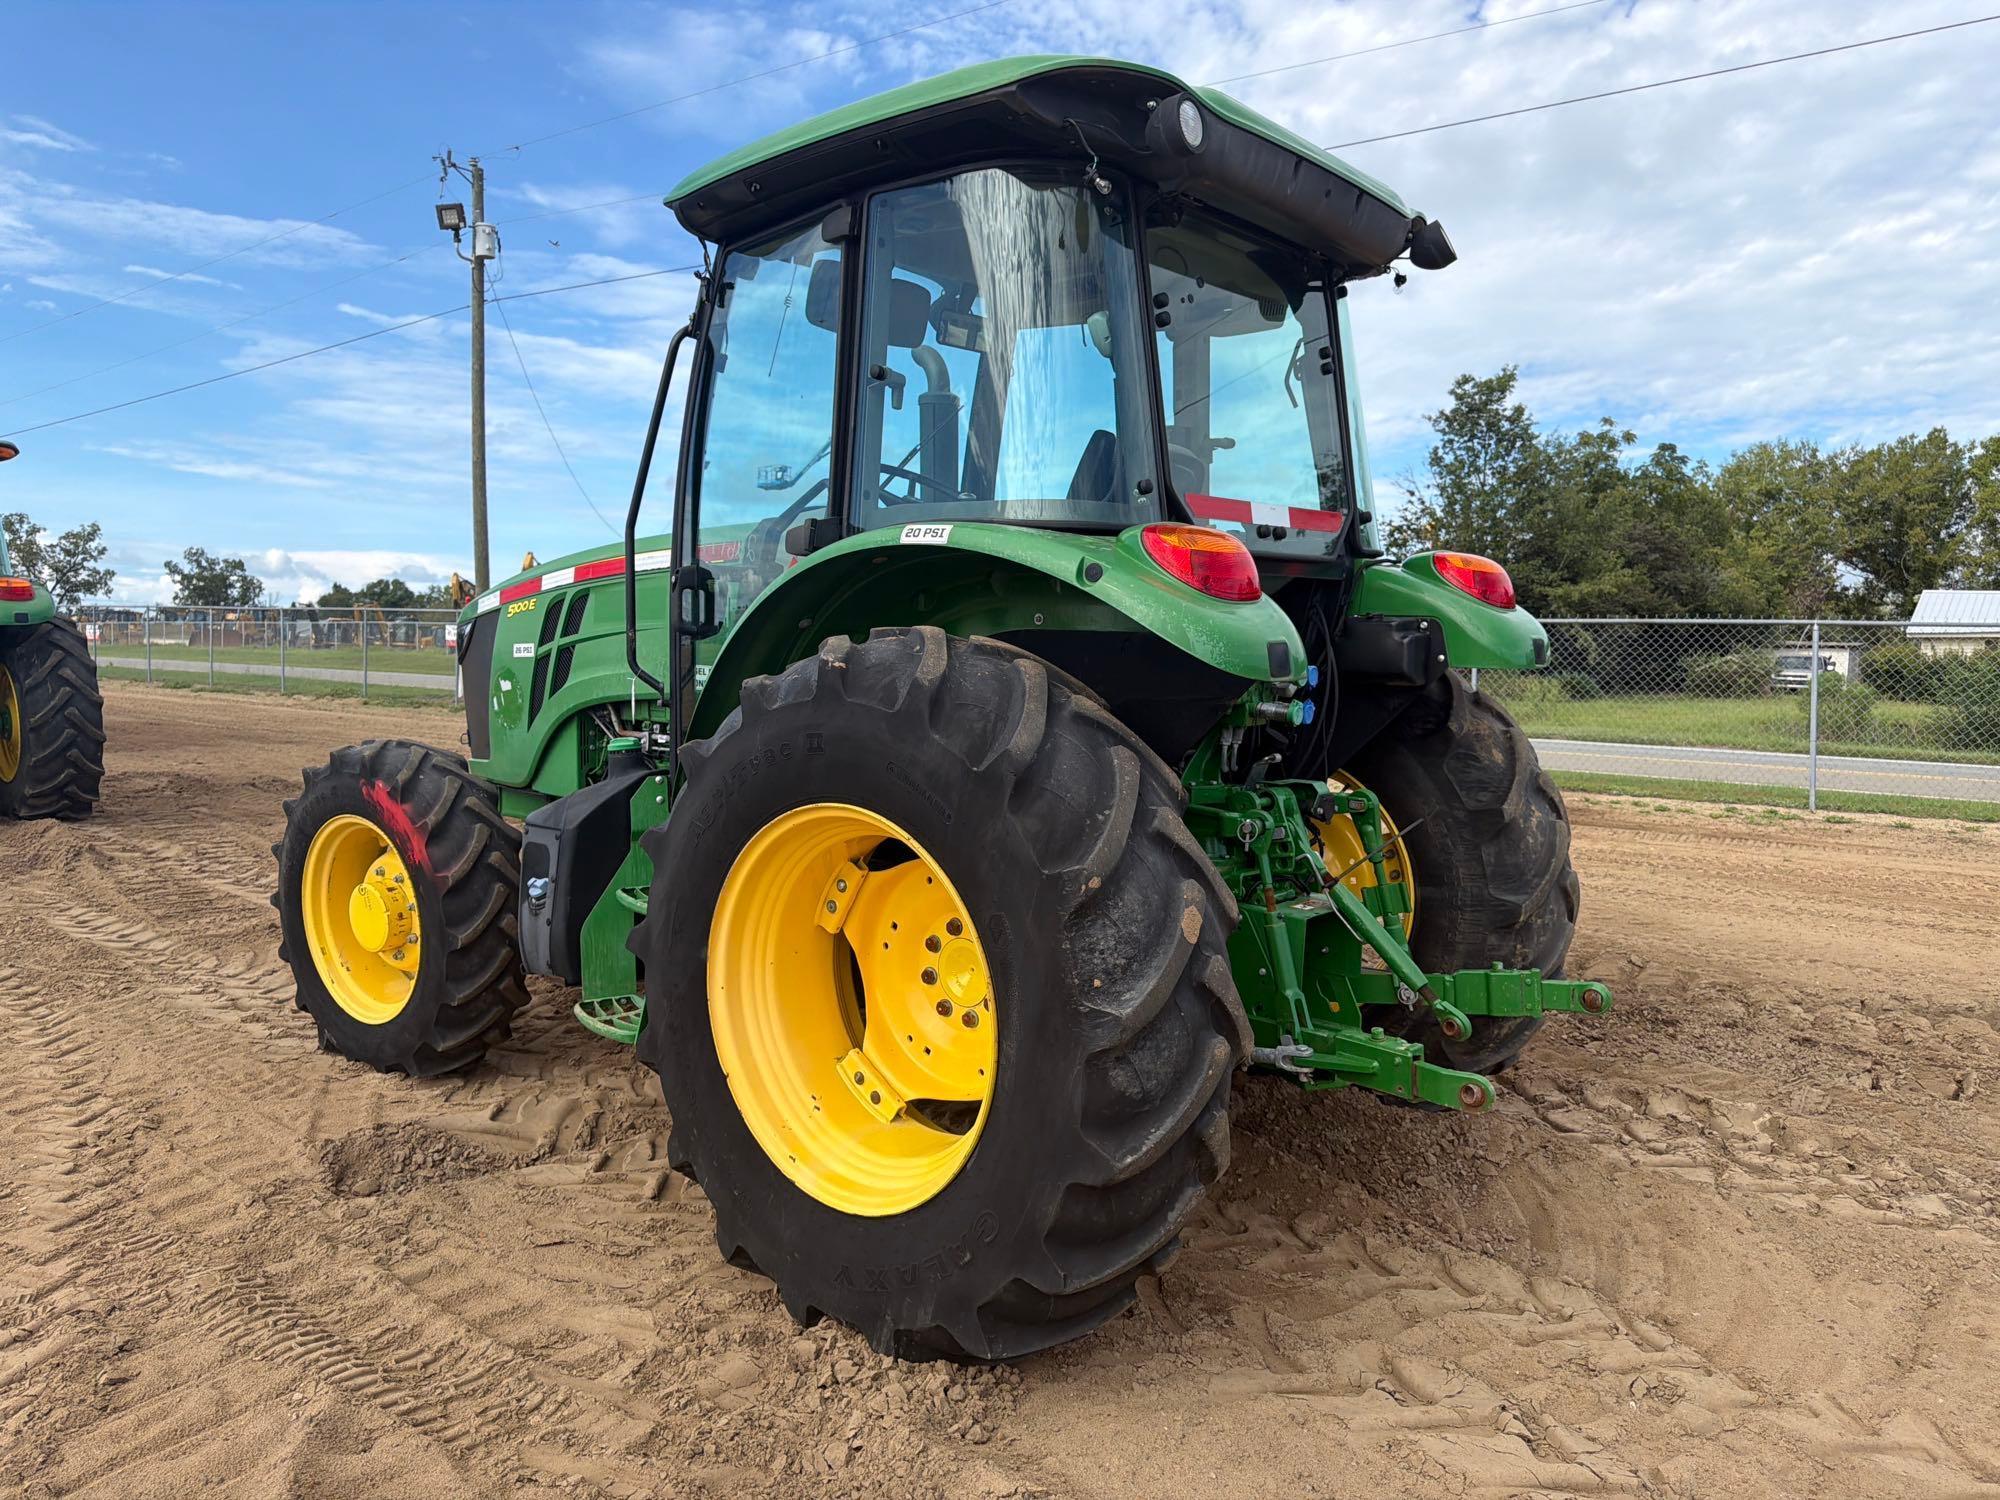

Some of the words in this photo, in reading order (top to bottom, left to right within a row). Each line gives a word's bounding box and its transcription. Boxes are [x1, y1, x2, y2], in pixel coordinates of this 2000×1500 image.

[905, 527, 922, 538] 20
[923, 527, 947, 538] PSI
[523, 646, 532, 654] PSI
[832, 1209, 1000, 1293] GALAXY
